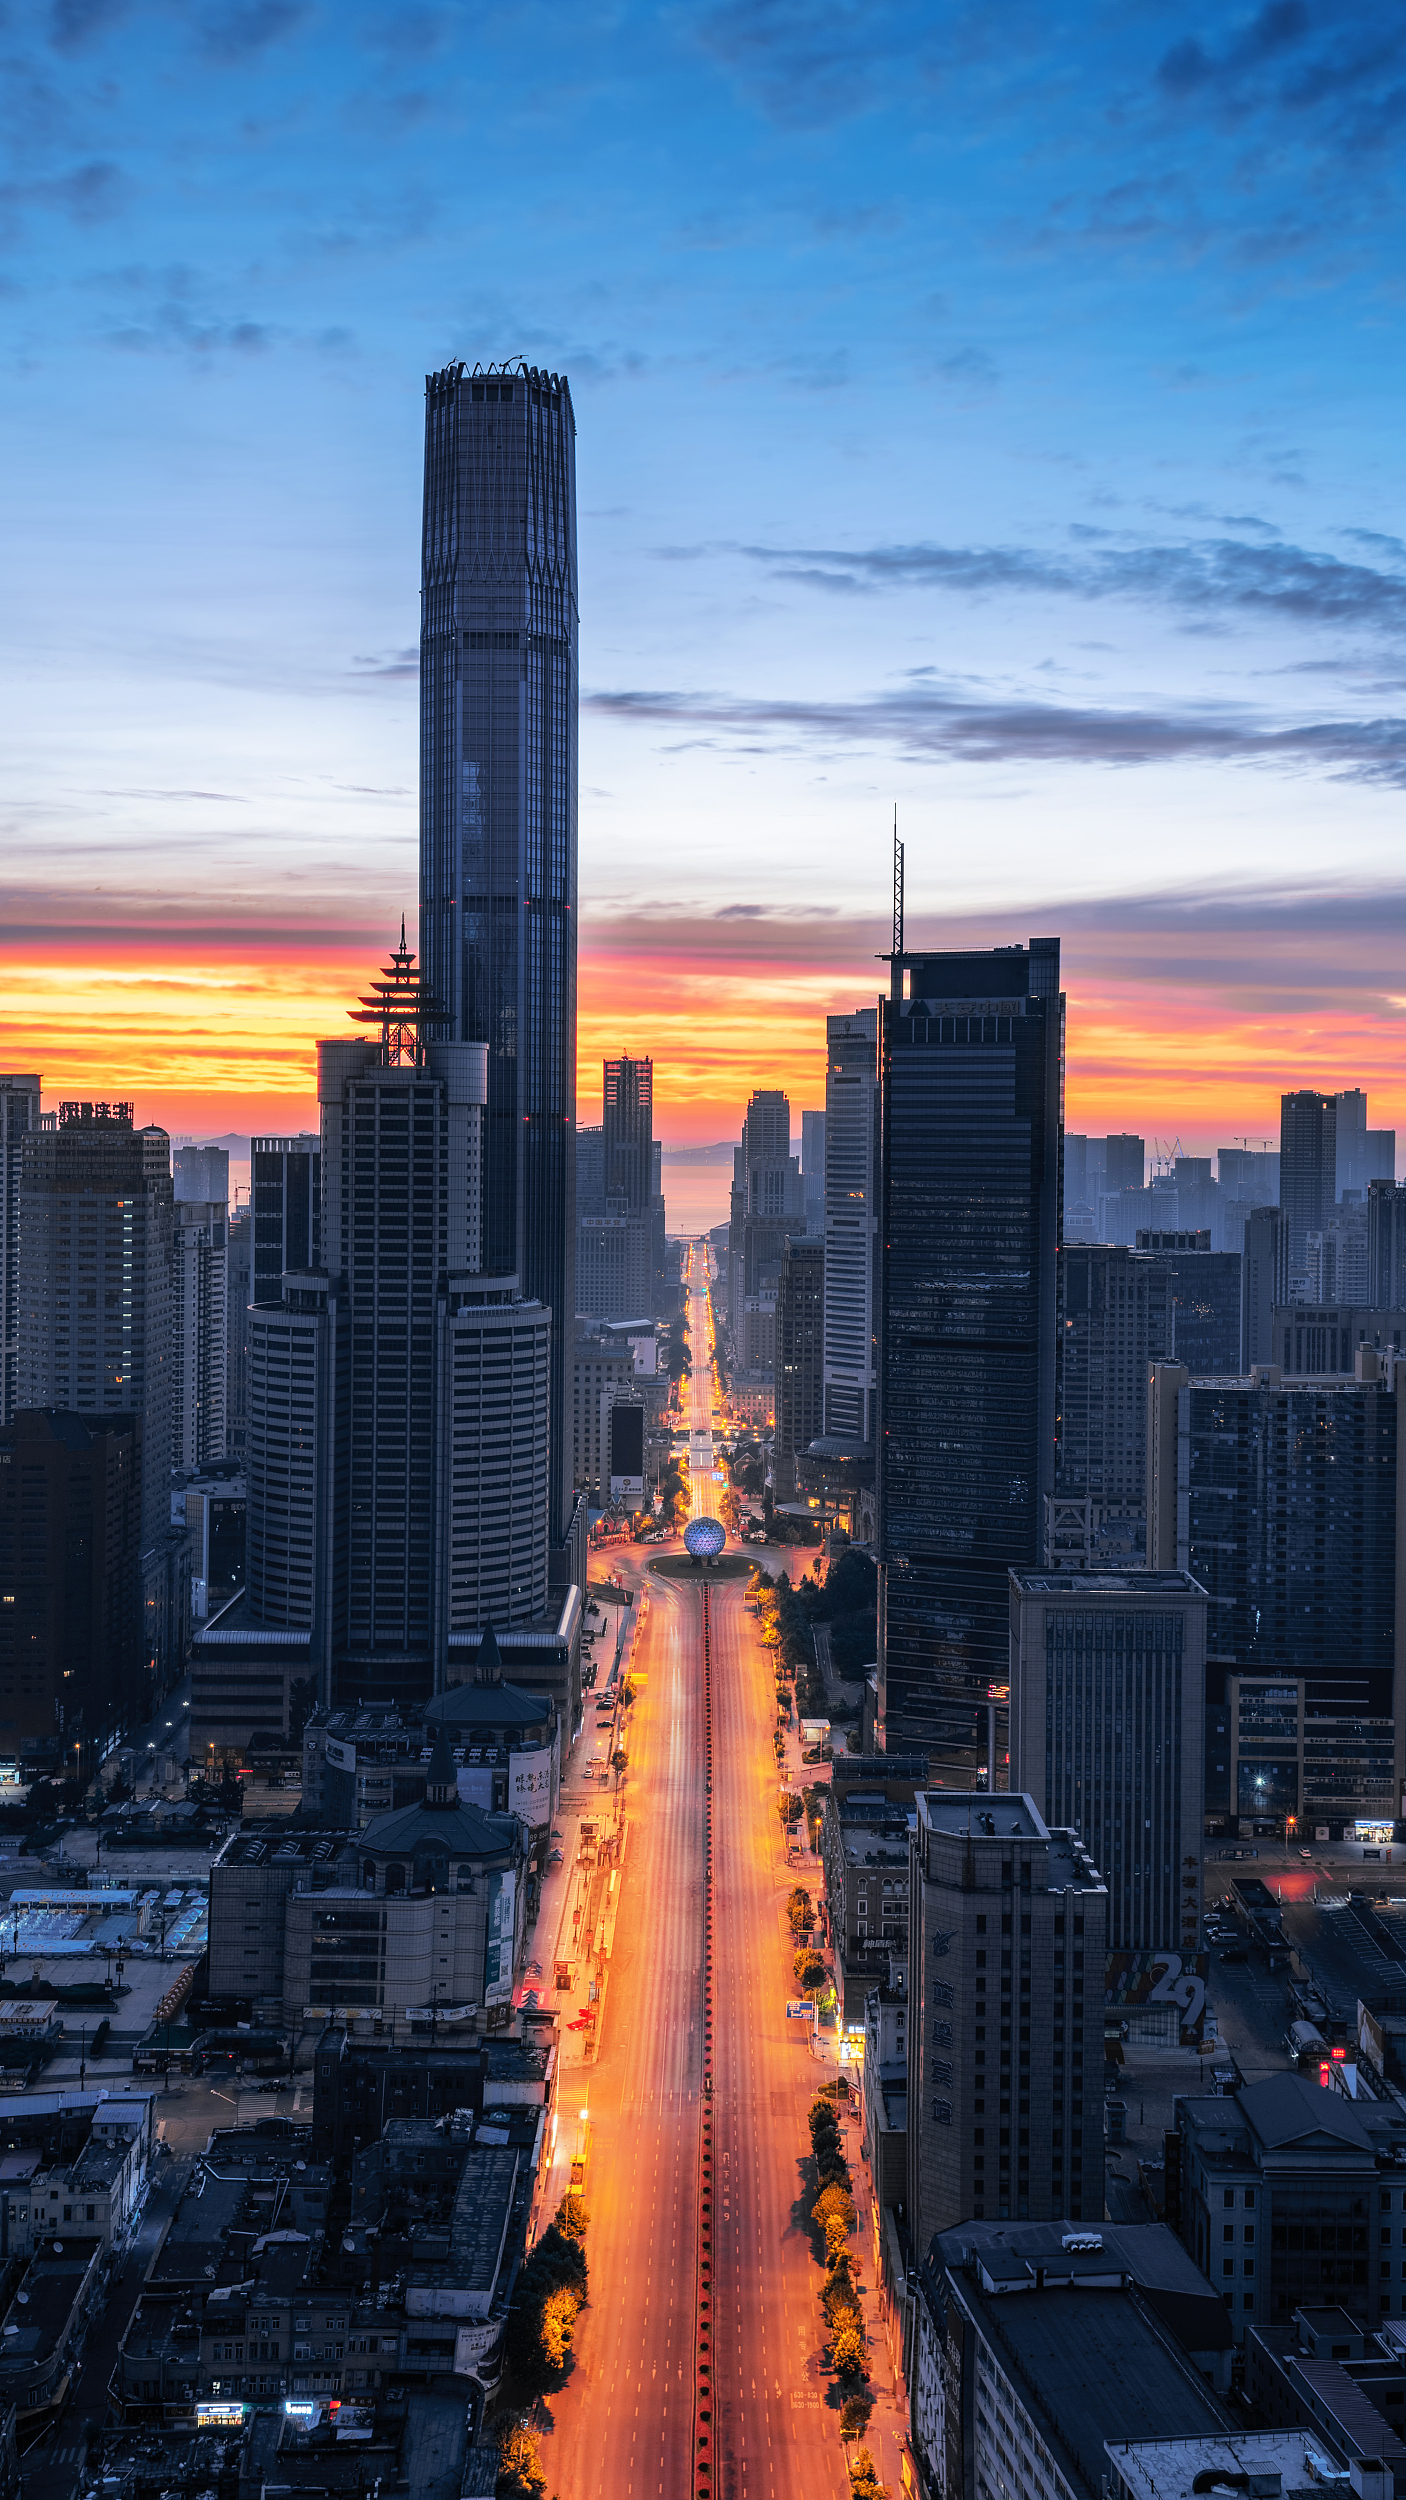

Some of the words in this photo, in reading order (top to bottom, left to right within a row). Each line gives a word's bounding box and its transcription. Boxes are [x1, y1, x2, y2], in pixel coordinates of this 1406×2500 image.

[935, 1001, 1020, 1016] 天安中國
[1181, 1856, 1199, 1949] 丰源大酒店
